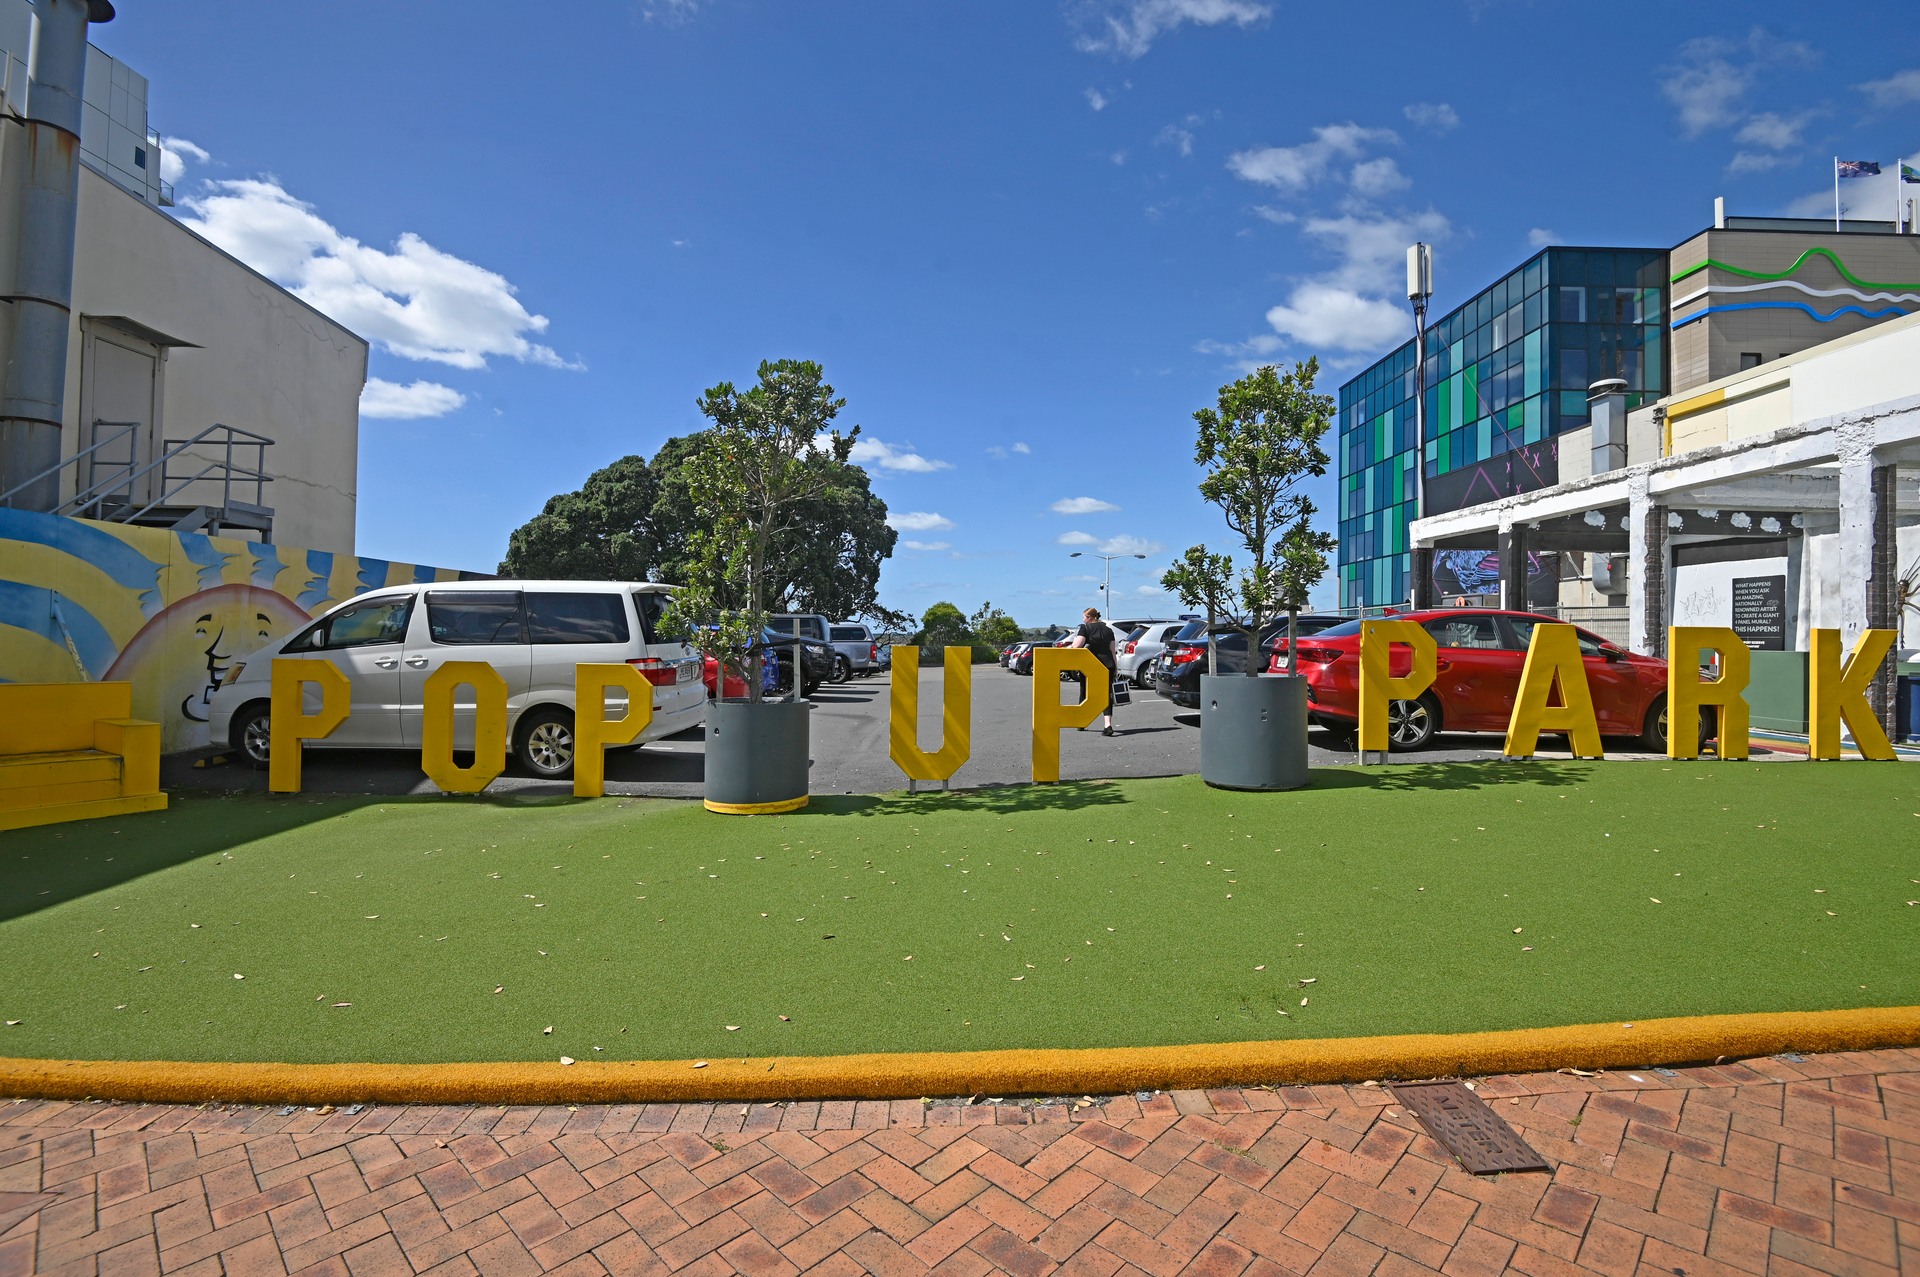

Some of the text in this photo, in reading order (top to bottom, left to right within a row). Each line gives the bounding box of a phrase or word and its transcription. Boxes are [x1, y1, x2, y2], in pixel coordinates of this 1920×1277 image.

[269, 619, 1898, 798] POP UP PARK
[1432, 1095, 1503, 1154] METER
